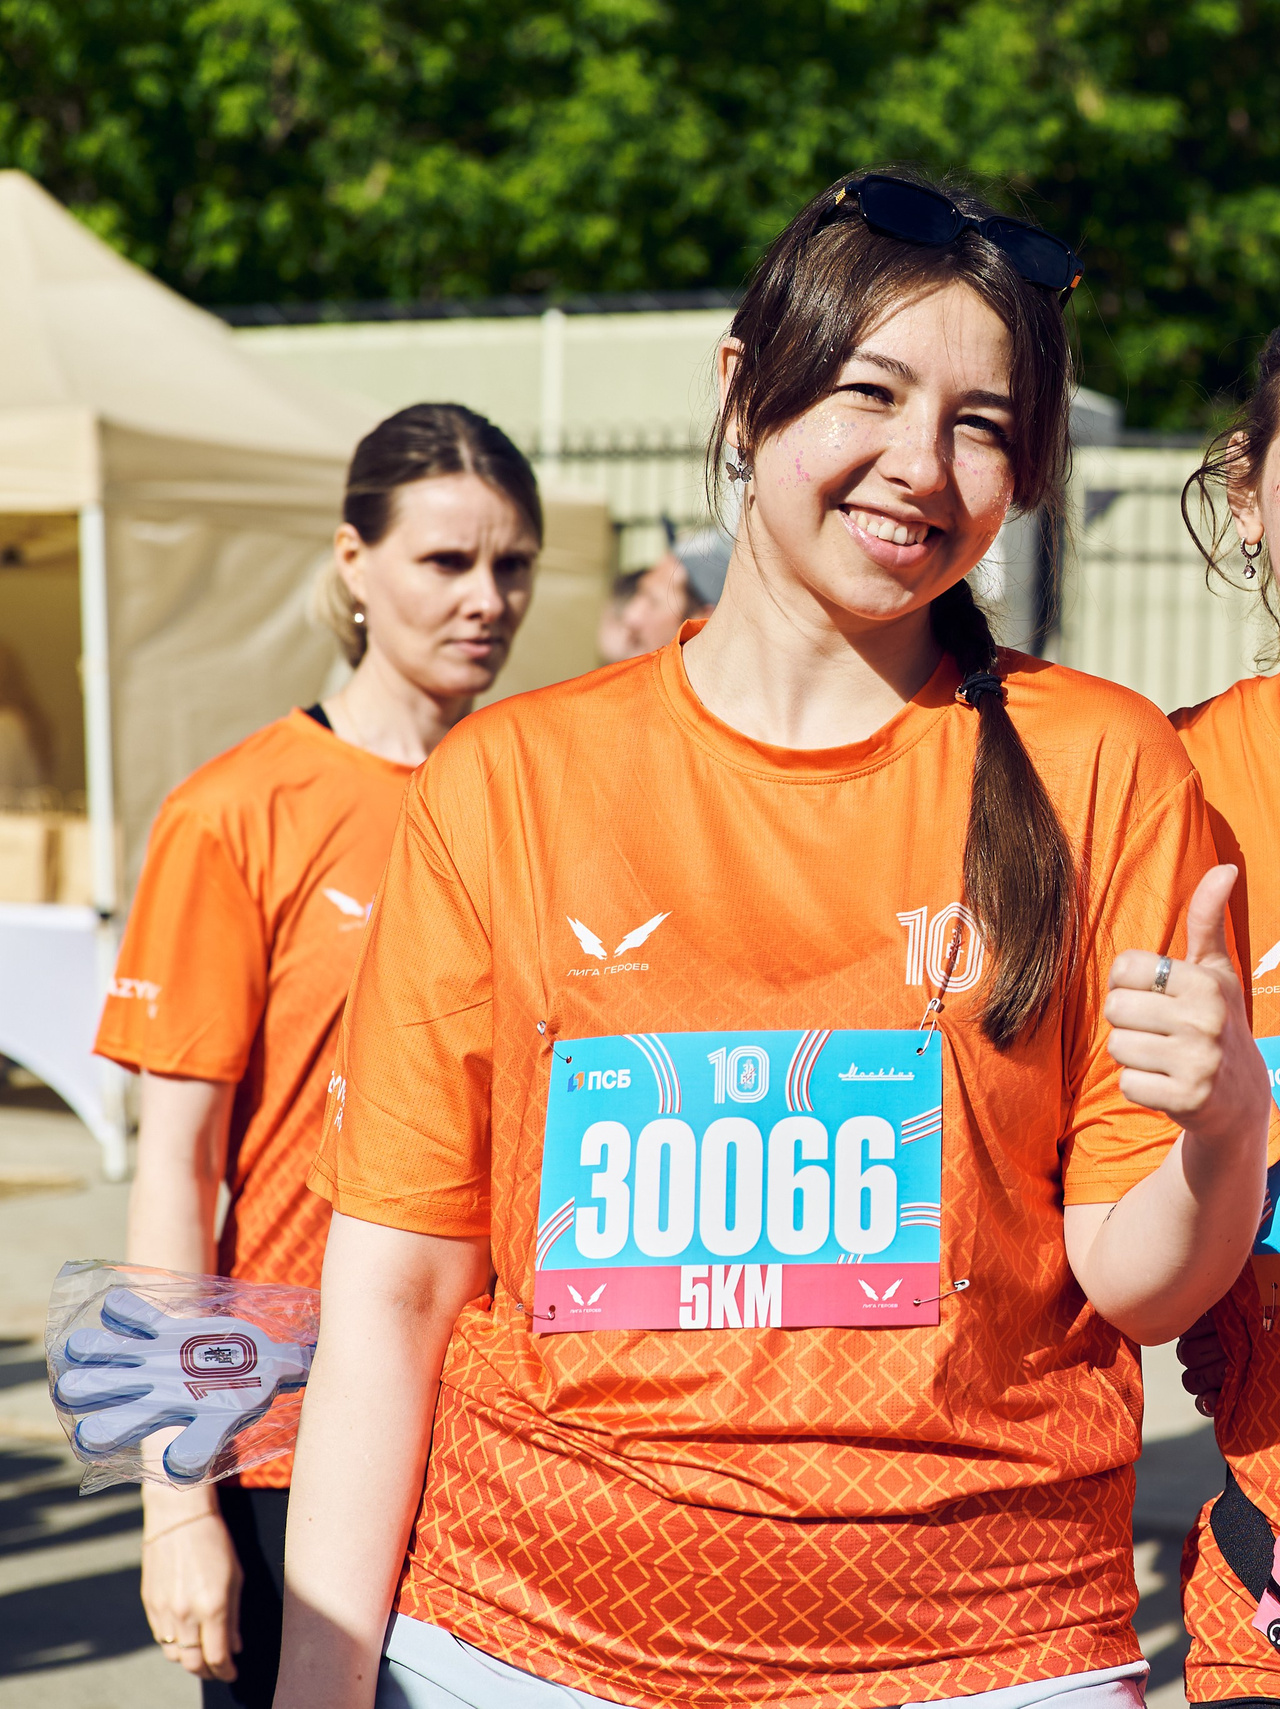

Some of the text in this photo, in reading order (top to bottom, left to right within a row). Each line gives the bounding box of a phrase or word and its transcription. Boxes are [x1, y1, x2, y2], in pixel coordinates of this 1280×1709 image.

[566, 962, 650, 977] ЛИГА ГЕРОЕВ
[895, 901, 985, 993] 10
[587, 1068, 632, 1091] ПСБ
[706, 1045, 770, 1105] 10
[574, 1115, 898, 1260] 30066
[179, 1332, 262, 1401] 10
